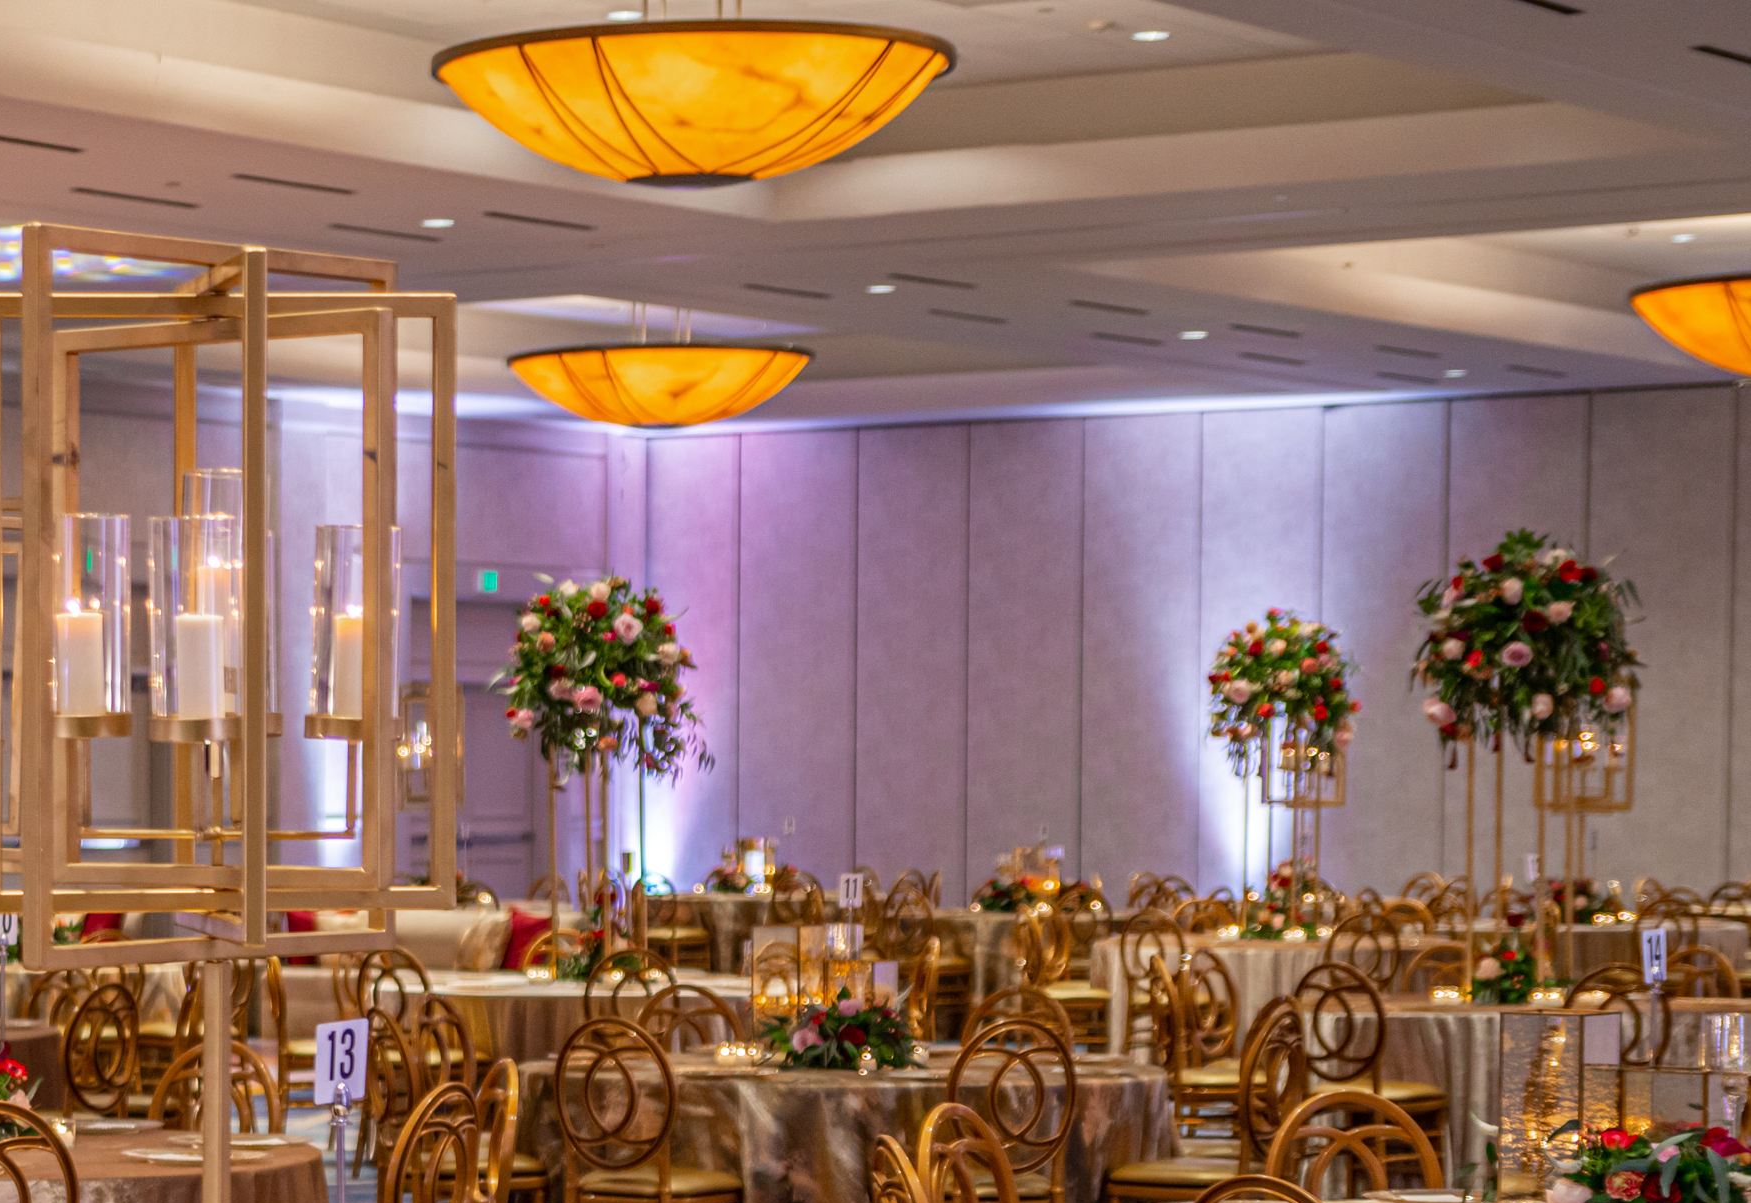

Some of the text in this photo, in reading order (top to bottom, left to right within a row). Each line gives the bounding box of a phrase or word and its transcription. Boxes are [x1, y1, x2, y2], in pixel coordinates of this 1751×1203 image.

[845, 878, 857, 898] 11
[1647, 935, 1661, 967] 14
[327, 1028, 356, 1081] 13
